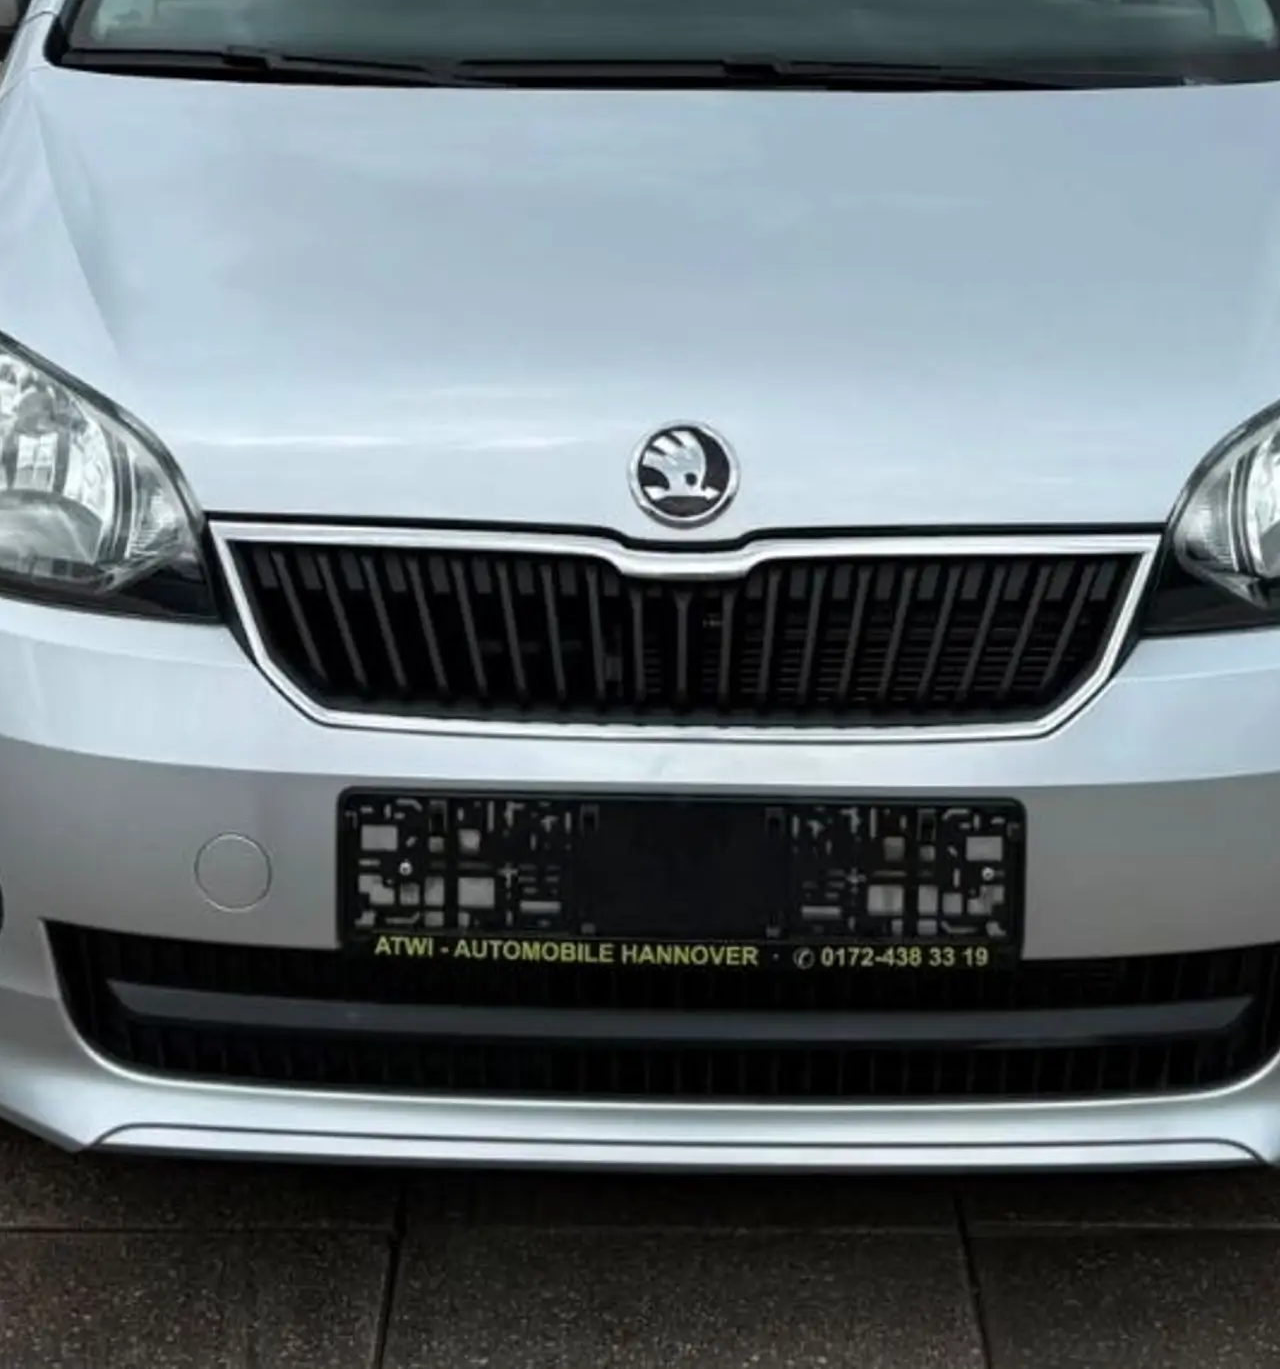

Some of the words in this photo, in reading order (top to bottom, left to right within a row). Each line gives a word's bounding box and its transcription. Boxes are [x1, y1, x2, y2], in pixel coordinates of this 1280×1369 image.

[375, 935, 434, 956] ATWI
[453, 939, 614, 963] AUTOMOBILE
[621, 944, 759, 966] HANNOVER
[821, 947, 922, 966] 0172-438
[928, 947, 955, 966] 33
[964, 947, 988, 966] 19
